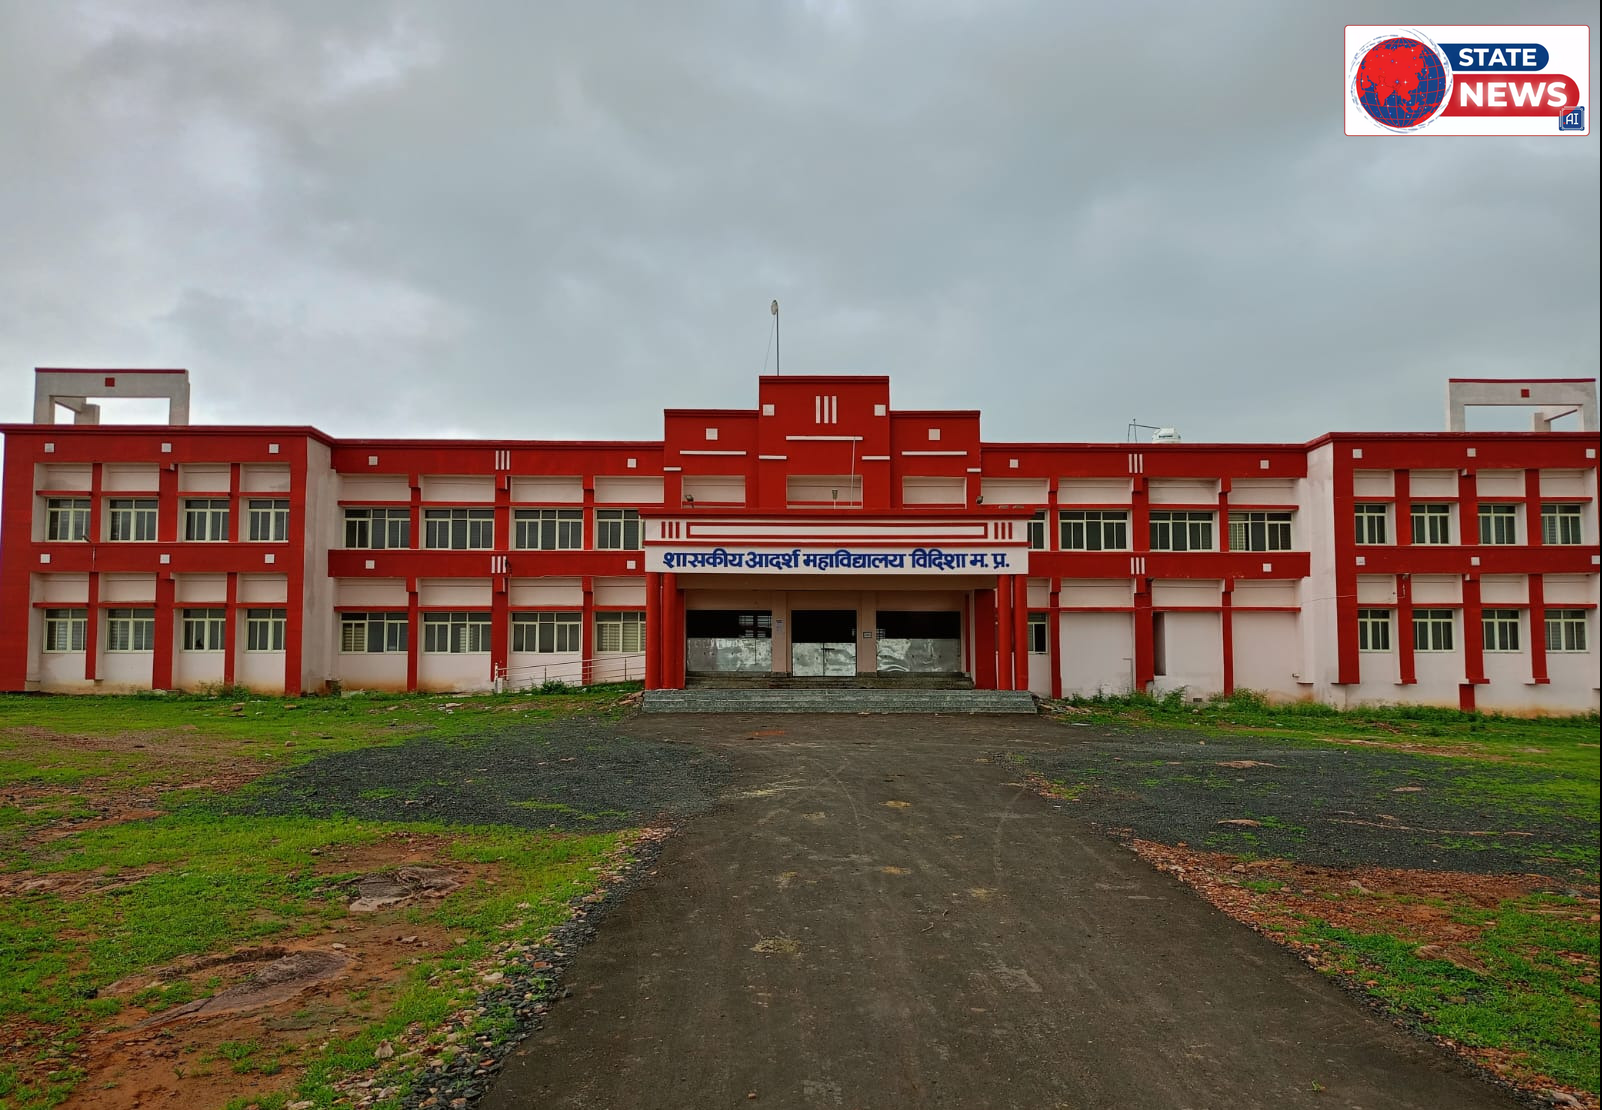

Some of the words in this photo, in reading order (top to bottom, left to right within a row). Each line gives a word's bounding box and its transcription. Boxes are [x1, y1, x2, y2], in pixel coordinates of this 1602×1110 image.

[662, 547, 745, 569] शासकीय
[745, 549, 802, 570] आदर्श
[803, 548, 906, 570] महाविद्यालय
[908, 548, 969, 571] विदिशा
